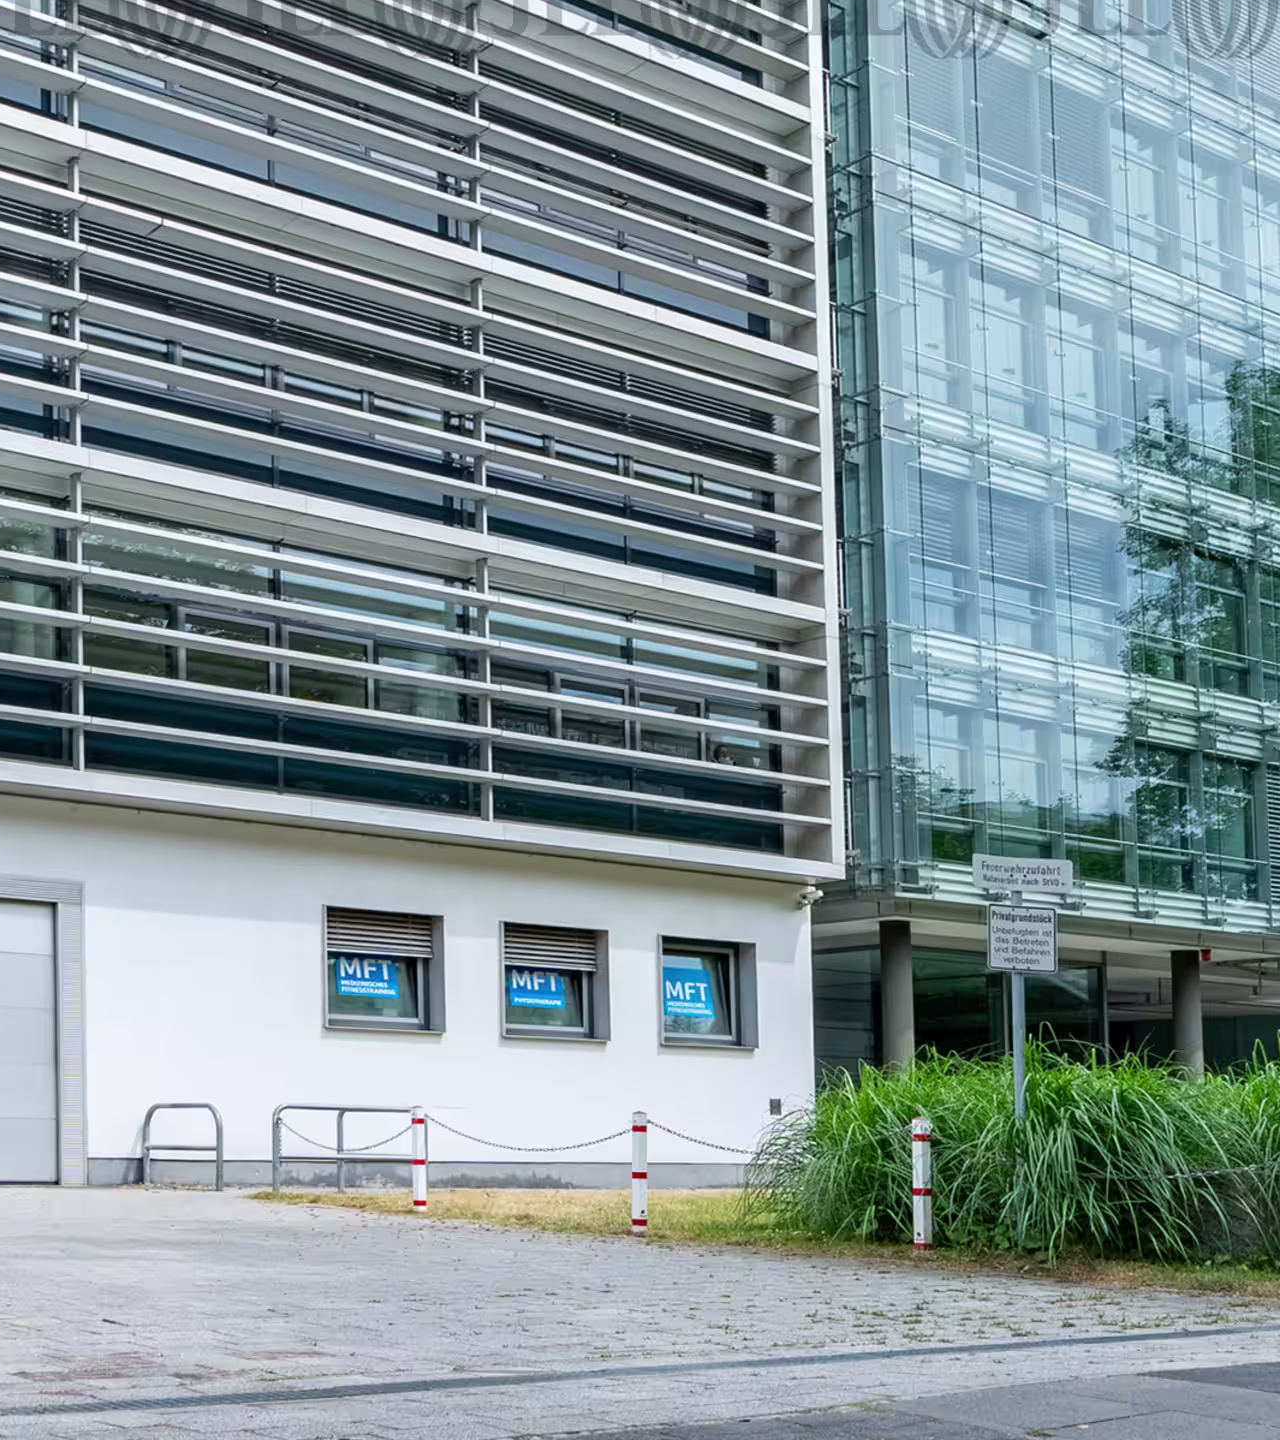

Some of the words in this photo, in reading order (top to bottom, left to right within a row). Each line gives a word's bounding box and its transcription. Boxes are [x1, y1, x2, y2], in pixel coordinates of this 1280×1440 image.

[981, 860, 1061, 876] Feuerwehrzufahrt
[1021, 877, 1039, 885] nach
[991, 910, 1052, 924] Privatgrundstück
[991, 925, 1039, 937] Unbefugten
[1042, 929, 1052, 937] ist
[995, 936, 1009, 945] das
[1012, 937, 1049, 947] Betreten
[994, 946, 1008, 954] und
[1012, 946, 1051, 956] Befahren
[1002, 956, 1040, 965] verboten
[340, 956, 392, 980] MFT
[511, 969, 559, 992] MFT
[665, 980, 708, 1001] MFT
